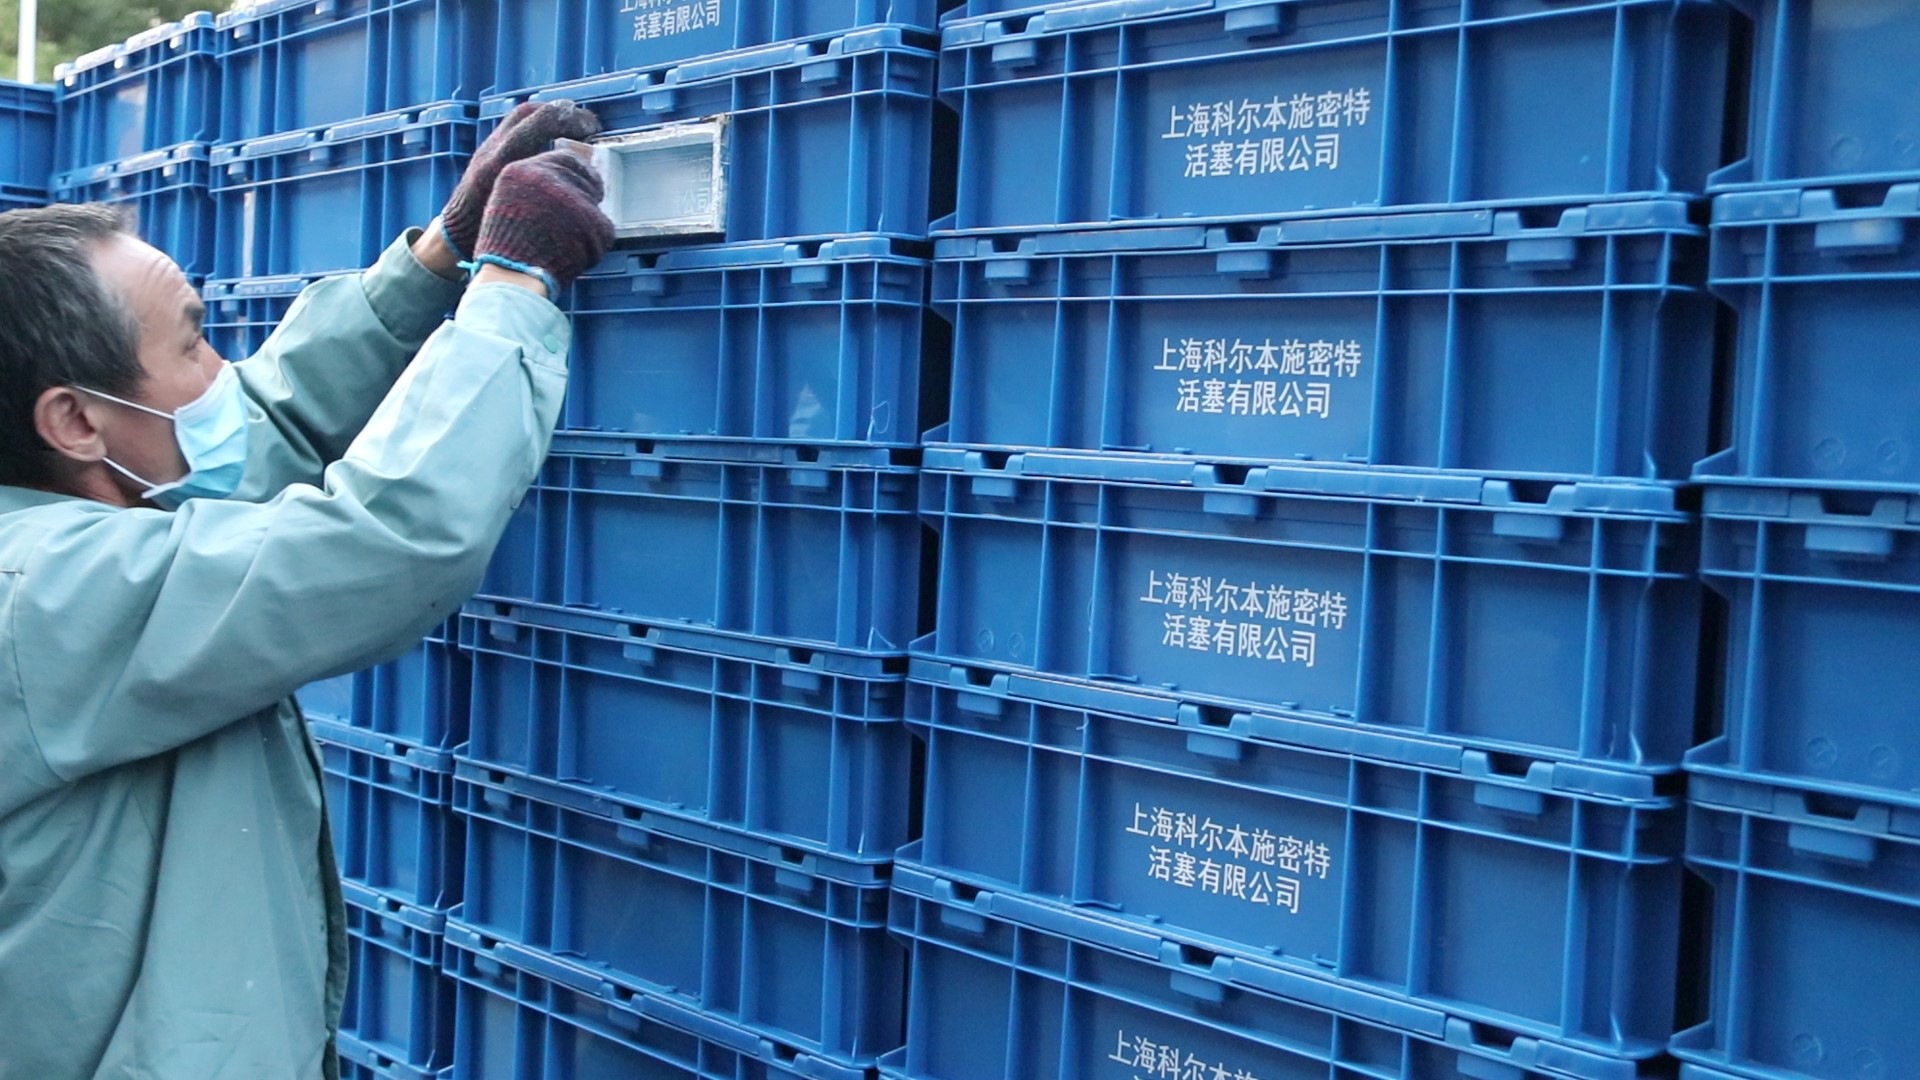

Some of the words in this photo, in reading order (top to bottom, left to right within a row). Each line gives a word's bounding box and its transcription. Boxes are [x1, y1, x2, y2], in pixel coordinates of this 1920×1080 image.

[633, 0, 720, 41] 活塞有限公司
[1161, 87, 1371, 139] 上海科尔本施密特
[1184, 133, 1340, 178] 活塞有限公司
[1153, 337, 1362, 378] 上海科尔本施密特
[1175, 378, 1331, 419] 活塞有限公司
[1140, 570, 1348, 630] 上海科尔本施密特
[1162, 612, 1316, 668] 活塞有限公司
[1125, 802, 1331, 880] 上海科尔本施密特
[1147, 845, 1300, 914] 活塞有限公司
